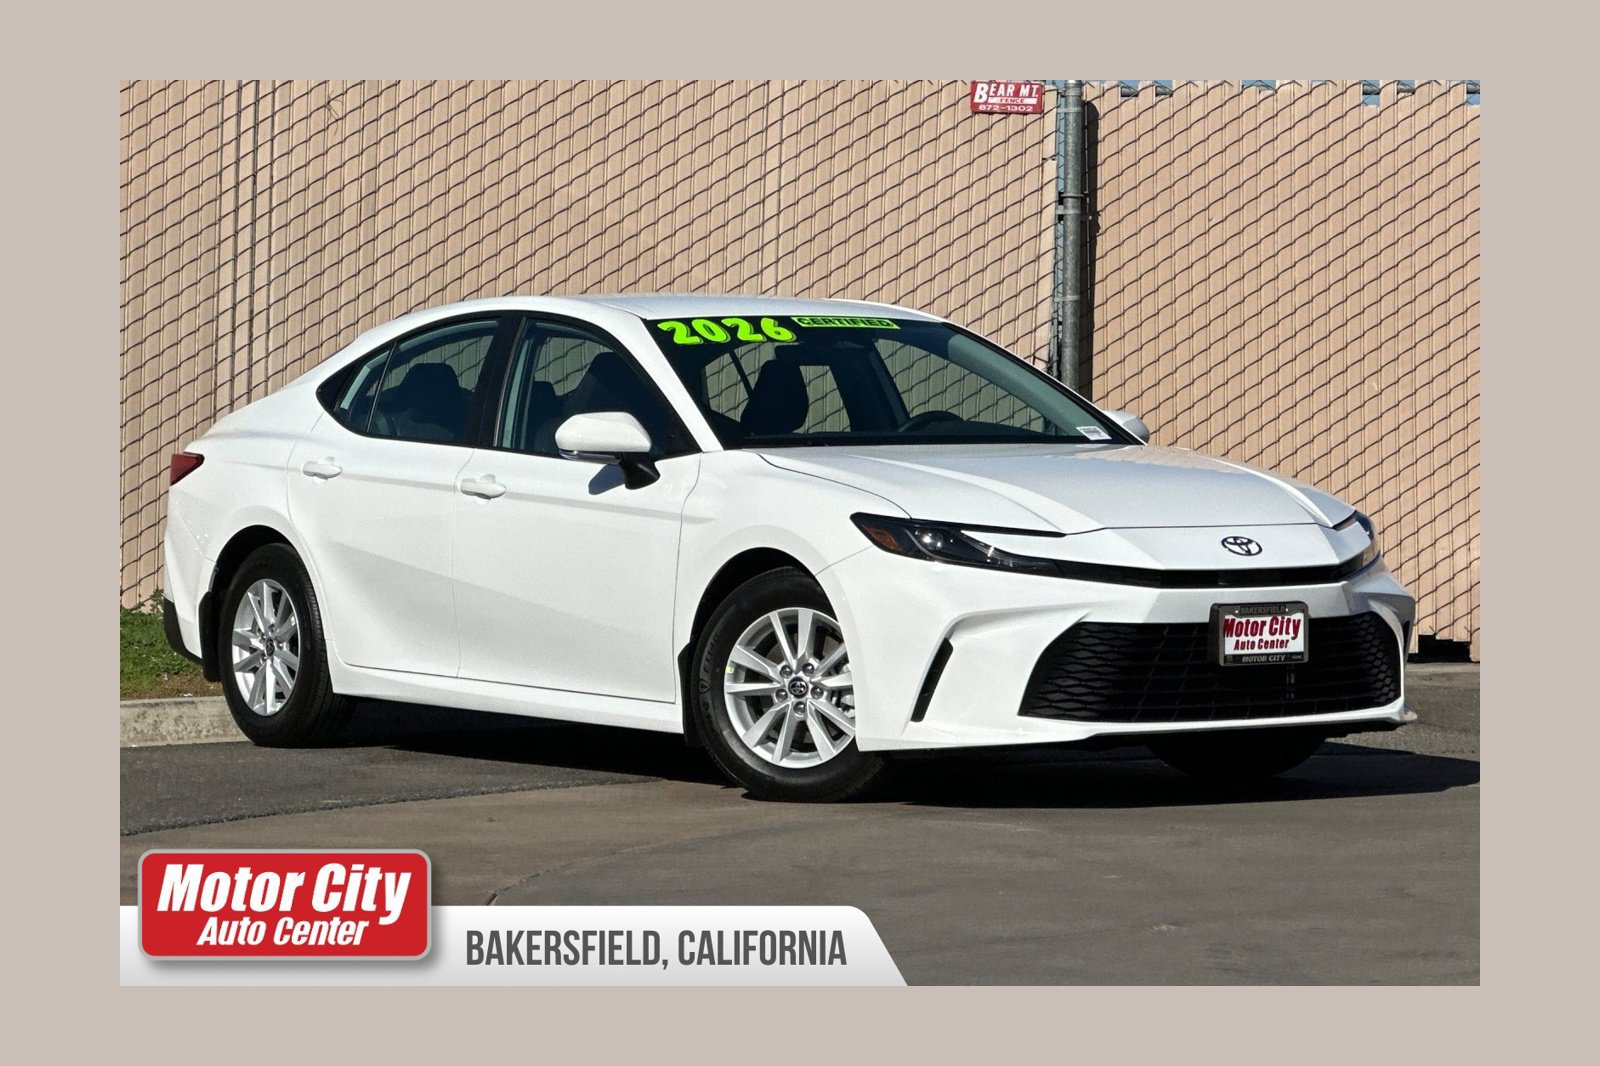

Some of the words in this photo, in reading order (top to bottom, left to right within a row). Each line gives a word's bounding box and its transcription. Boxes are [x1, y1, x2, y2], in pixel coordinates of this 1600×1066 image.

[973, 83, 1015, 103] BEAR
[1018, 84, 1039, 97] MT.
[978, 104, 1033, 112] 872-1302
[797, 316, 891, 328] CERTIFIED
[657, 317, 797, 345] 2026
[1223, 618, 1266, 638] Motor
[1269, 616, 1301, 640] City
[1234, 639, 1256, 651] Auto
[1257, 638, 1289, 650] Center
[1241, 655, 1267, 663] MOTOR
[1268, 654, 1286, 662] CITY
